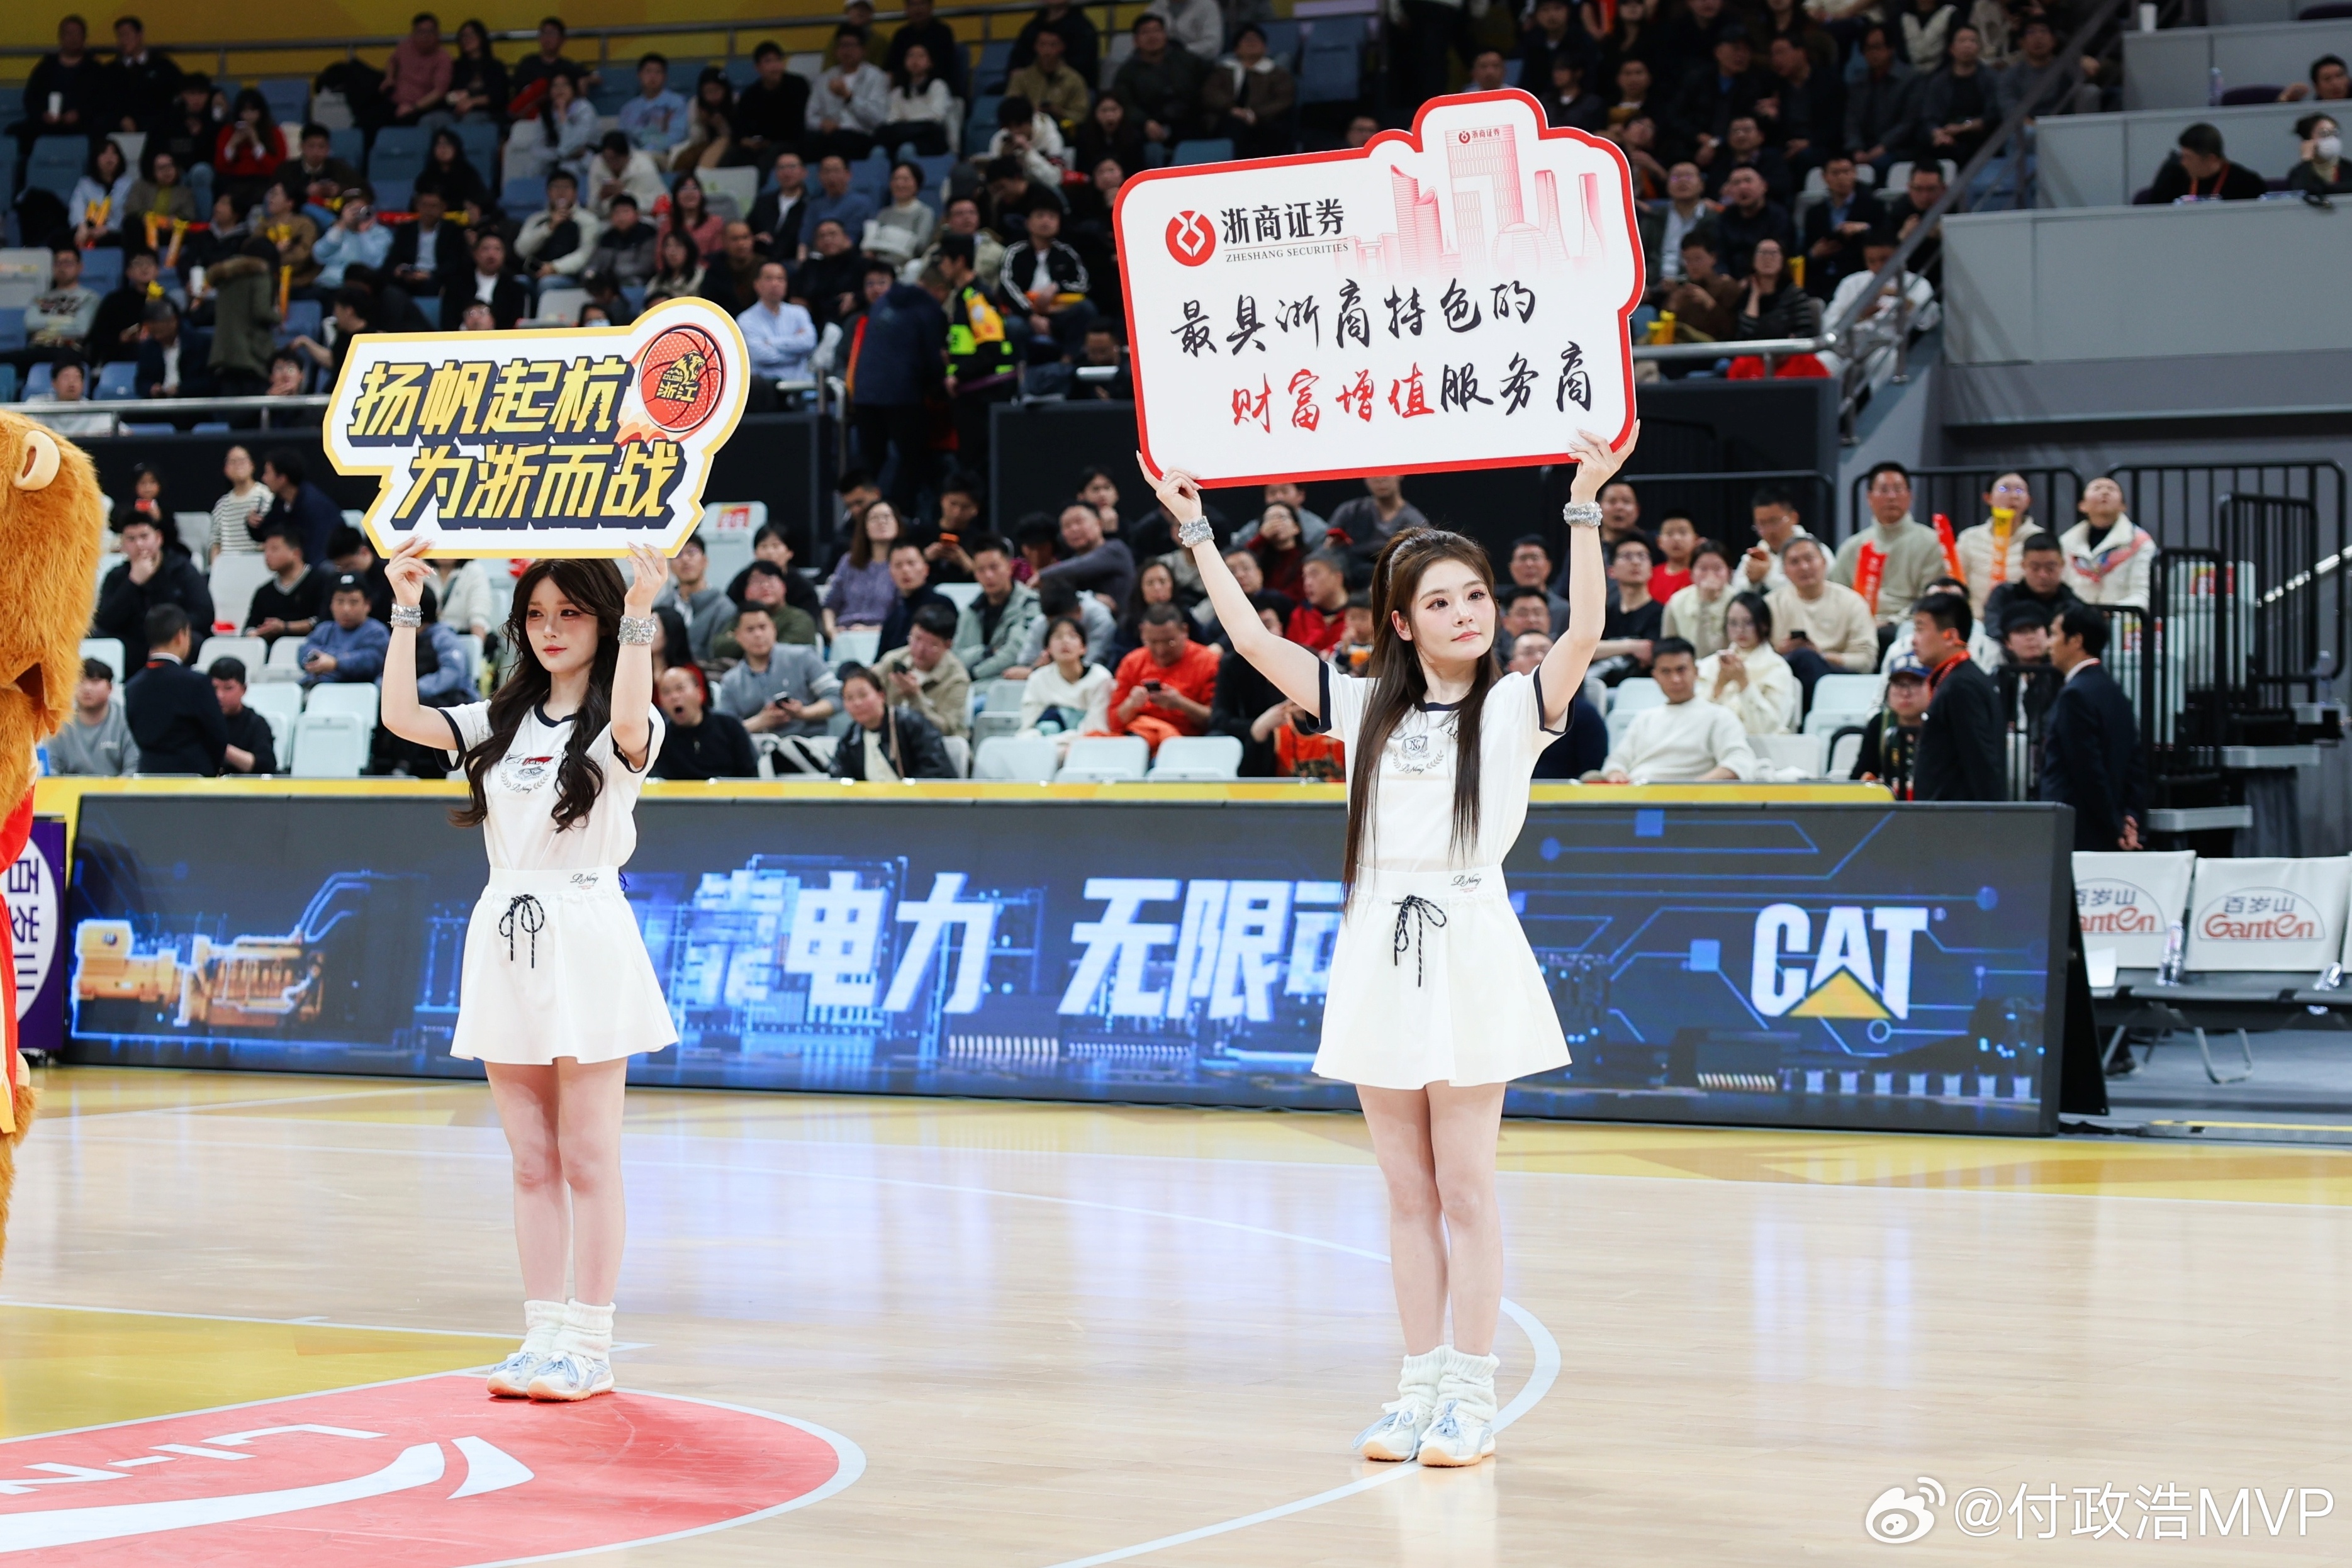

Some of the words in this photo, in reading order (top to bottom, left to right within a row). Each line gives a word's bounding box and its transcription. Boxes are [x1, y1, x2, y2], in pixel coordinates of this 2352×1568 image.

[1472, 128, 1499, 138] 浙商证券
[1220, 198, 1344, 244] 浙商证券
[1226, 250, 1284, 262] ZHESHANG
[1287, 243, 1348, 257] SECURITIES
[1171, 278, 1535, 357] 最具浙商特色的
[347, 356, 633, 446] 扬帆起杭
[656, 381, 698, 402] 浙江
[1231, 340, 1591, 434] 财富增值服务商
[391, 440, 686, 530] 为浙而战
[8, 856, 39, 990] 百岁山
[2079, 905, 2156, 932] anten
[2224, 895, 2296, 914] 百岁山
[1751, 904, 1929, 1019] CAT
